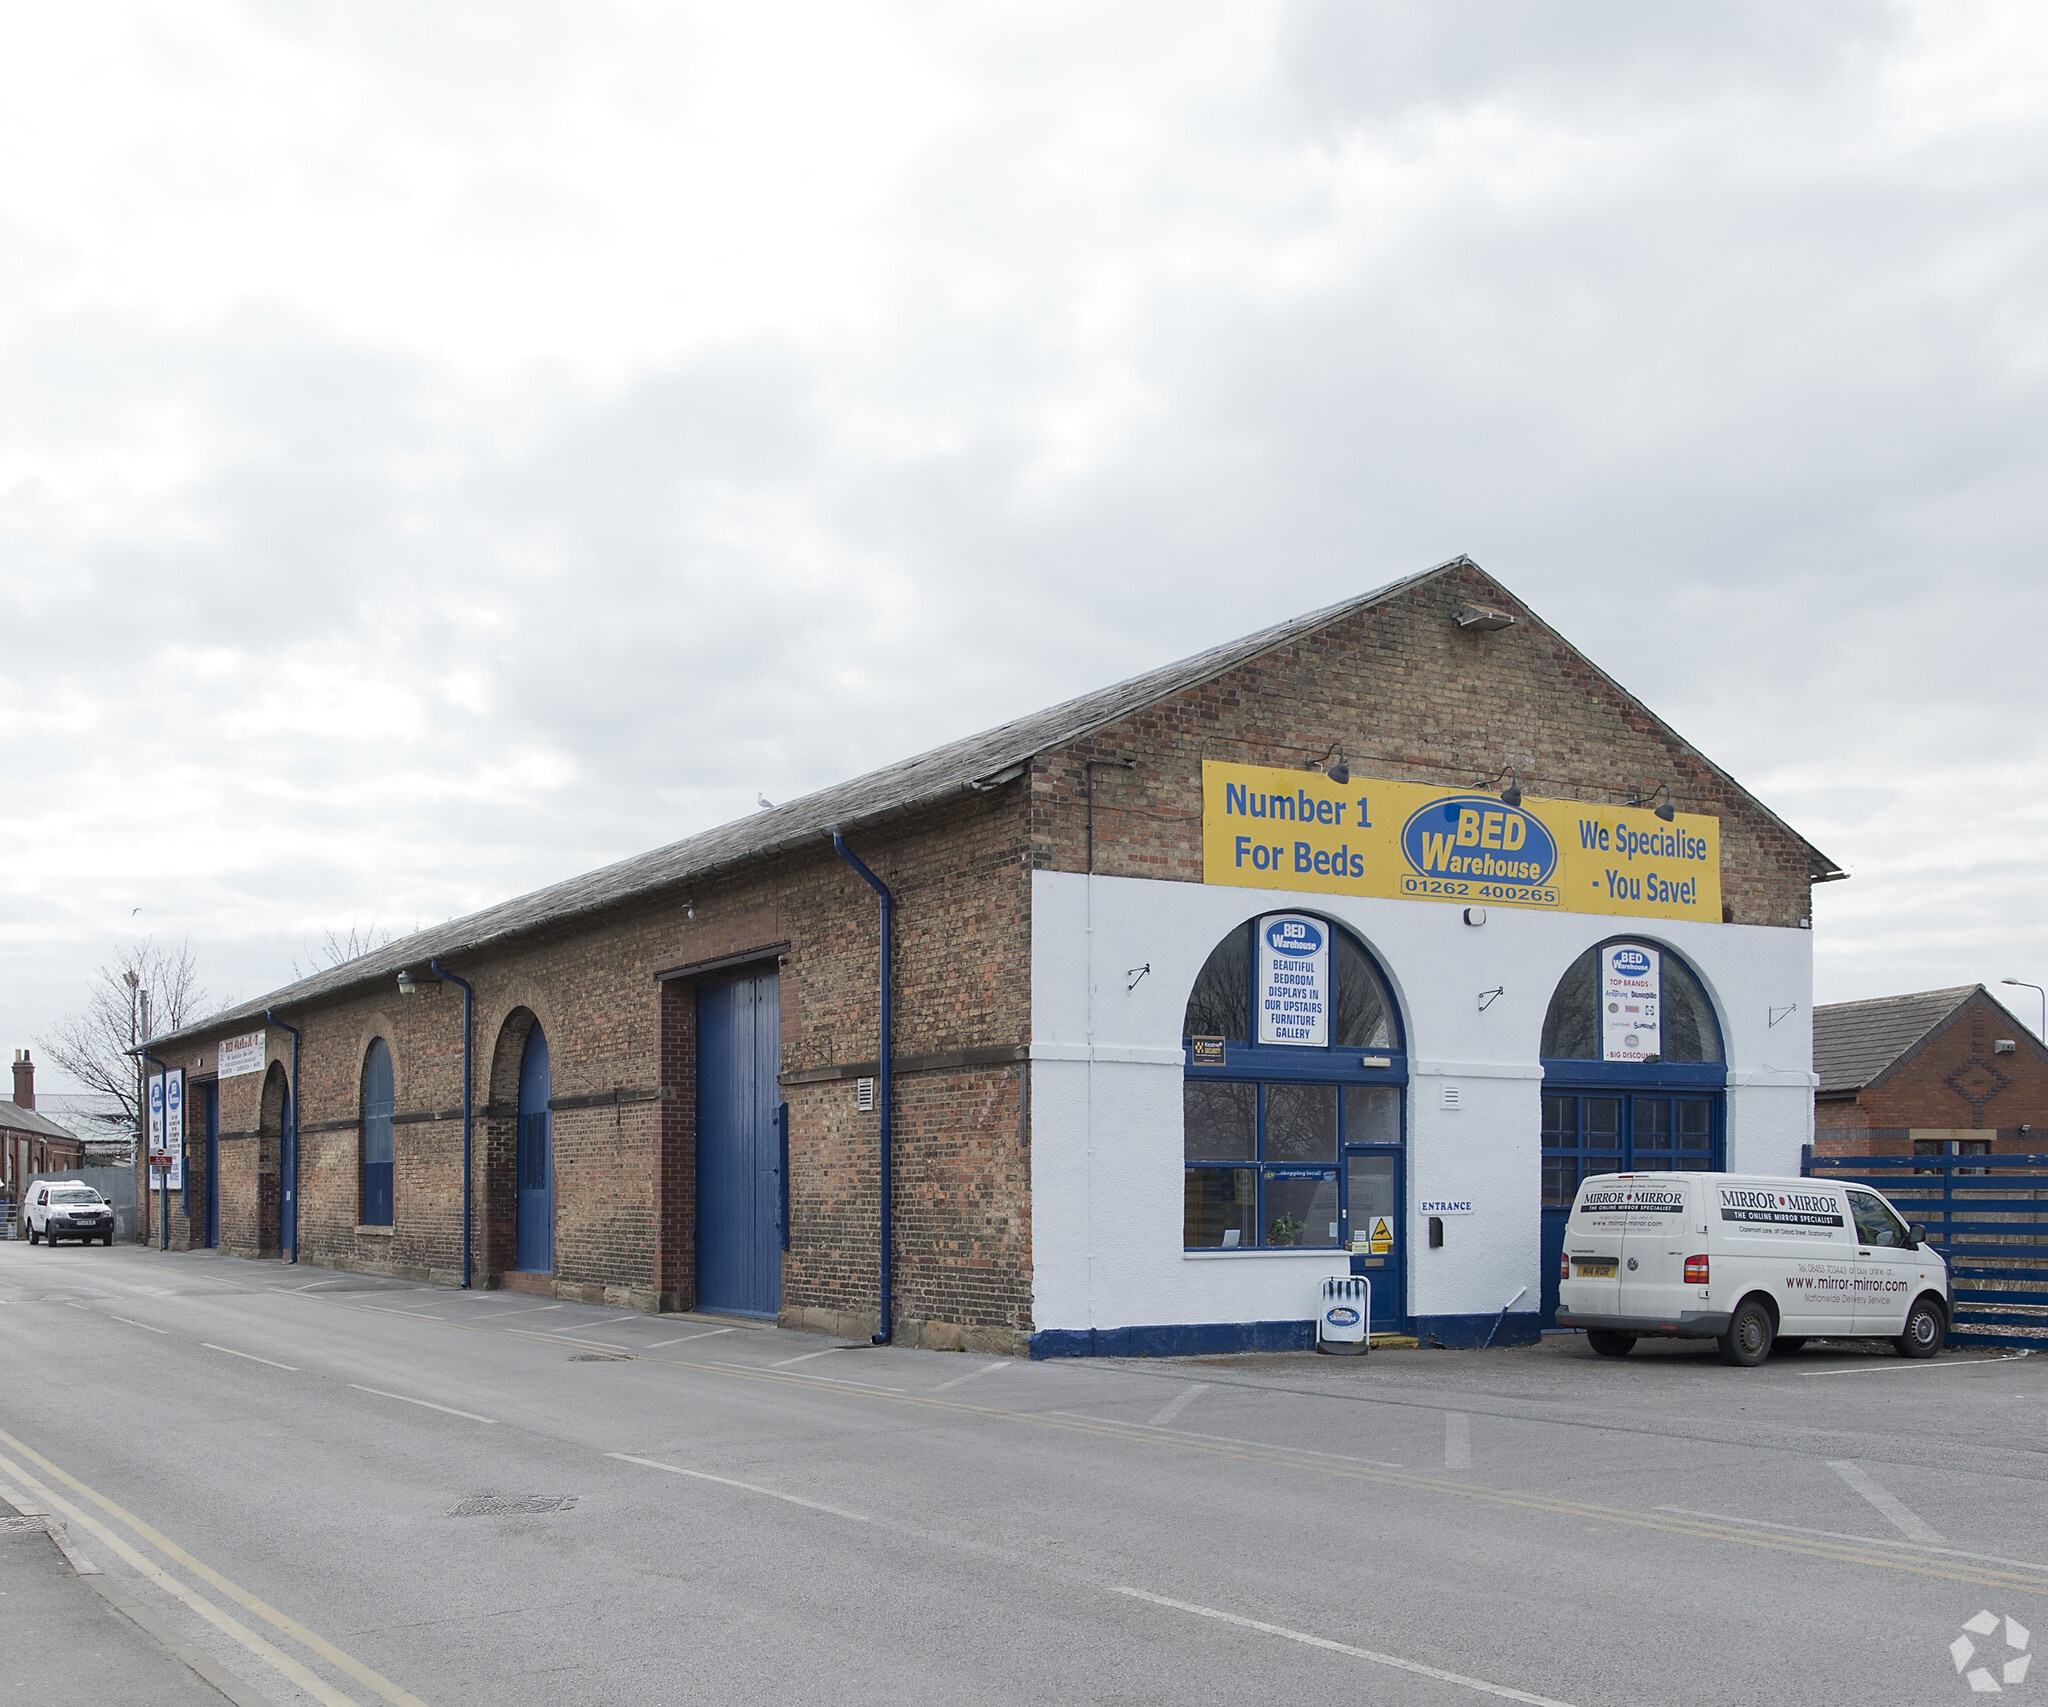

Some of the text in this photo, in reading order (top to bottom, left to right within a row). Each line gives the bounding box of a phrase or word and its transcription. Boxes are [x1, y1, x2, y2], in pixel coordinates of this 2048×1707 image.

[1226, 783, 1372, 828] Number 1
[1456, 808, 1526, 851] BED
[1579, 819, 1707, 860] We Specialise
[1235, 836, 1364, 878] For Beds
[1422, 831, 1541, 880] Warehouse
[1405, 879, 1555, 902] 01262 400265
[1605, 868, 1640, 900] You
[1647, 872, 1697, 904] Save!
[1283, 923, 1306, 938] BED
[1272, 934, 1317, 951] Warehouse
[1621, 952, 1643, 964] BED
[1273, 960, 1315, 973] BEAUTIFUL
[1613, 959, 1648, 971] Warehouse
[1274, 973, 1314, 986] BEDROOM
[1623, 980, 1649, 988] BRANDS
[1269, 986, 1319, 1000] DISPLAYS IN
[1265, 999, 1322, 1013] OUR UPSTAIRS
[1271, 1013, 1315, 1026] FURNITURE
[1276, 1027, 1310, 1039] GALLERY
[1584, 1192, 1682, 1204] MIRROR MIRROR
[1720, 1190, 1840, 1213] MIRROR MIRROR
[1422, 1201, 1471, 1211] ENTRANCE
[1734, 1211, 1833, 1224] THE ONLINE MIRROR SPECIALIST
[1808, 1230, 1833, 1238] Scarborough
[1807, 1264, 1826, 1274] 08453
[1857, 1266, 1867, 1276] buy
[1869, 1267, 1884, 1276] online
[1786, 1275, 1908, 1292] www.mirror-mirror.com
[1804, 1293, 1890, 1305] Nationwide Delivery Service
